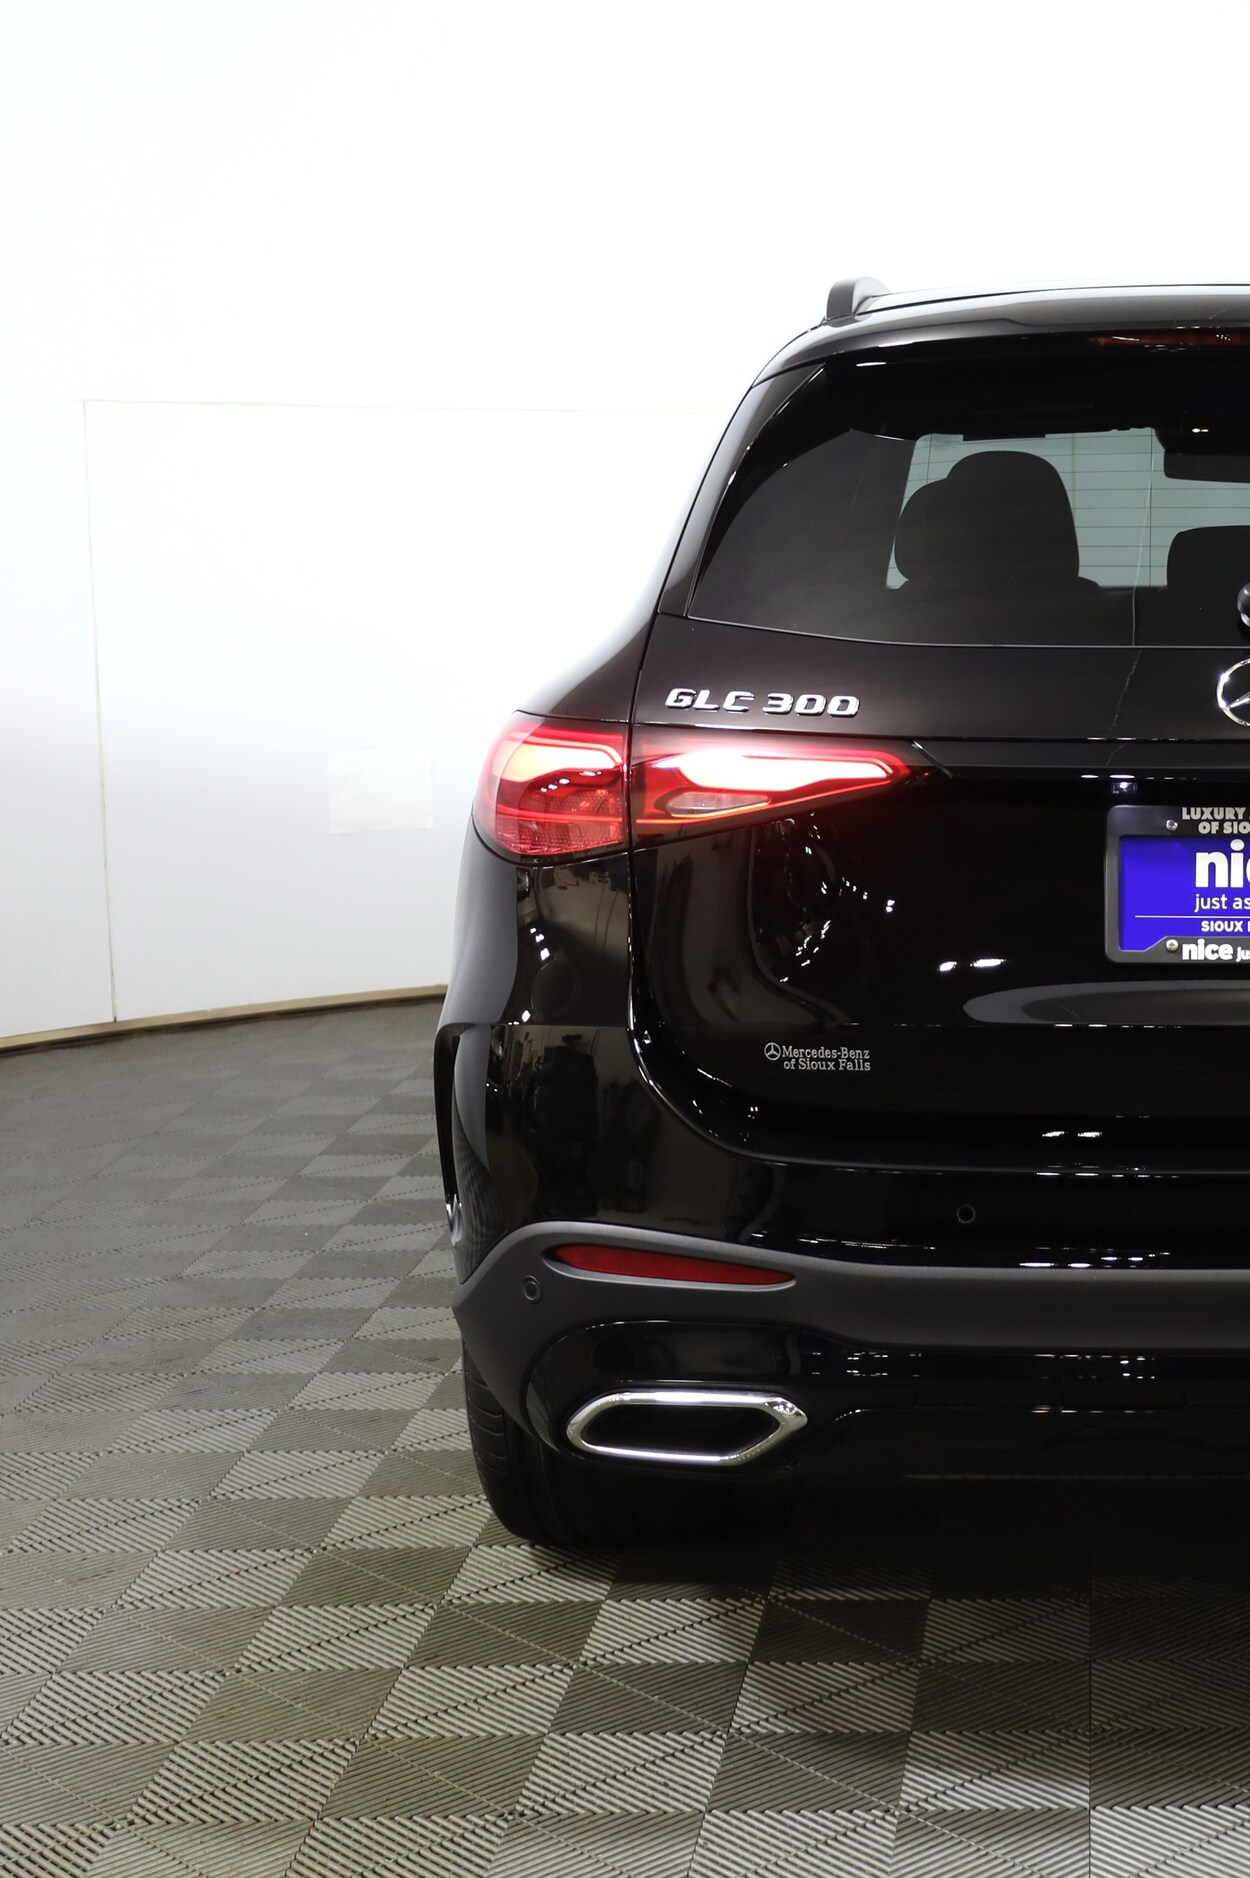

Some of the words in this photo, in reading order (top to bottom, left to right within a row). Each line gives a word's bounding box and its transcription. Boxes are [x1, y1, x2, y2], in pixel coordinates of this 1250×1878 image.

[665, 688, 754, 713] GLC
[762, 693, 860, 717] 300
[1182, 807, 1246, 820] LUXURY
[1198, 821, 1220, 834] OF
[1194, 895, 1228, 912] just
[1201, 921, 1243, 933] SIOUX
[1182, 939, 1234, 961] nice
[782, 1045, 870, 1059] Mercedes-Benz
[783, 1059, 796, 1070] of
[799, 1058, 836, 1071] Sioux
[839, 1059, 871, 1071] Falls
